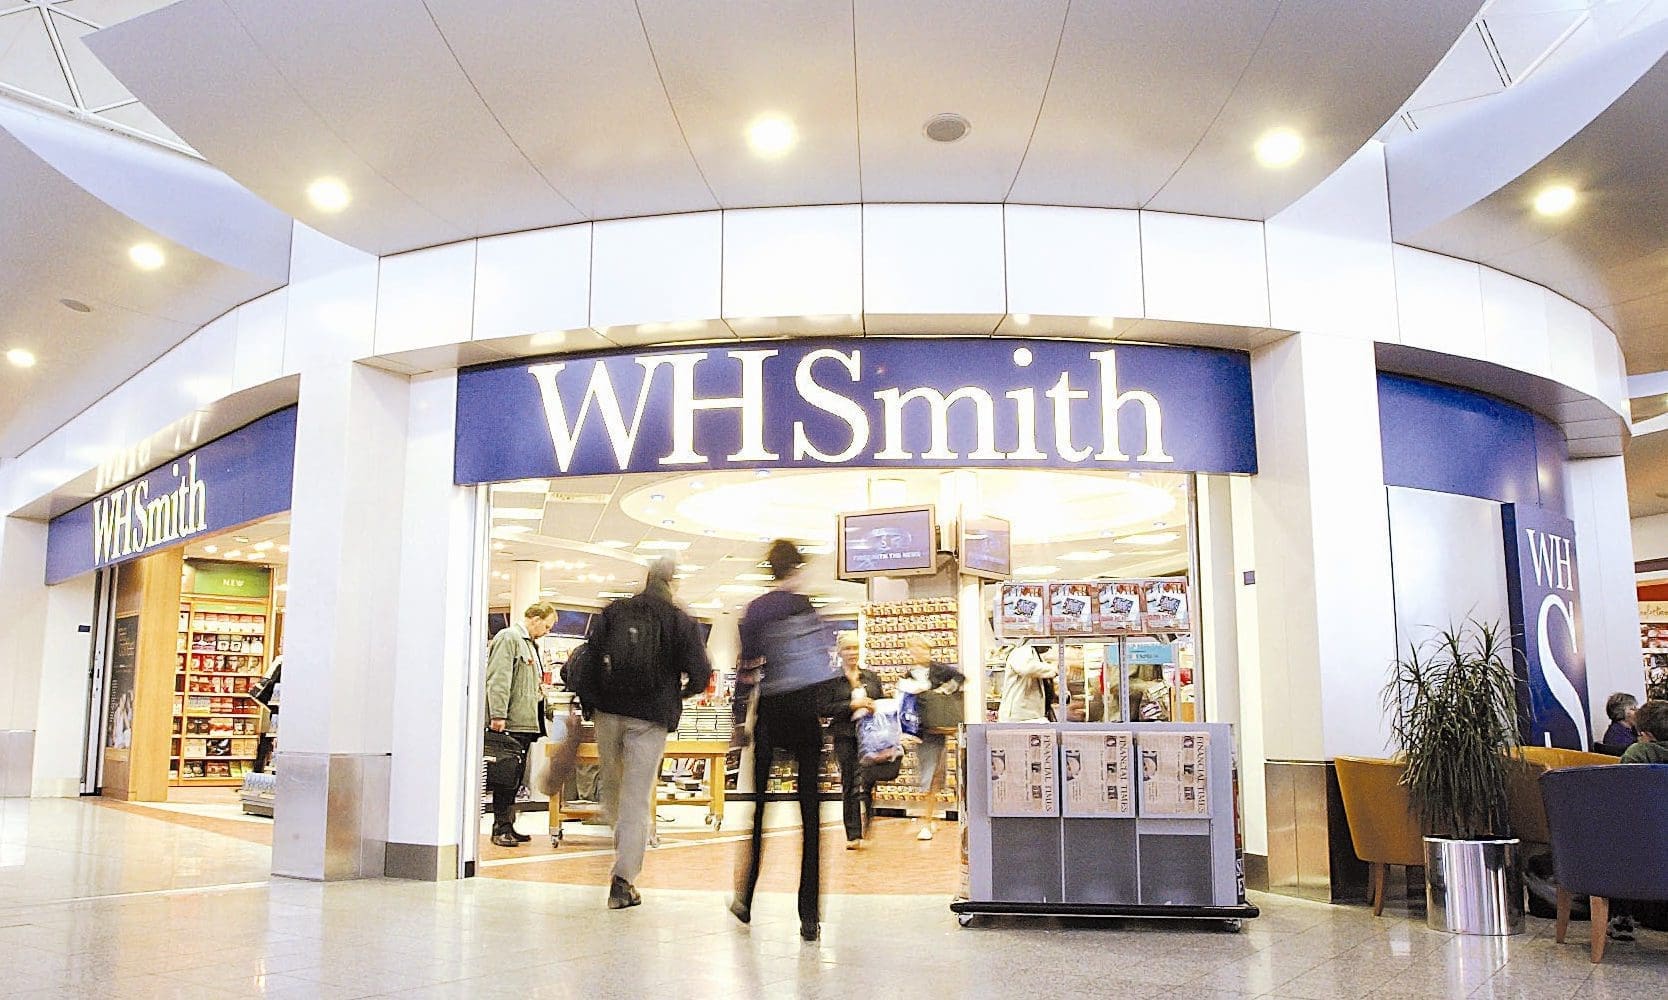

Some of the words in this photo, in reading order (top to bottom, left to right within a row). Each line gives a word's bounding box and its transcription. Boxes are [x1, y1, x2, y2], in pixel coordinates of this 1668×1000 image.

[528, 347, 1174, 473] WHSmith
[94, 455, 207, 566] WHSmith
[222, 578, 245, 587] NEW
[1525, 528, 1575, 592] WH
